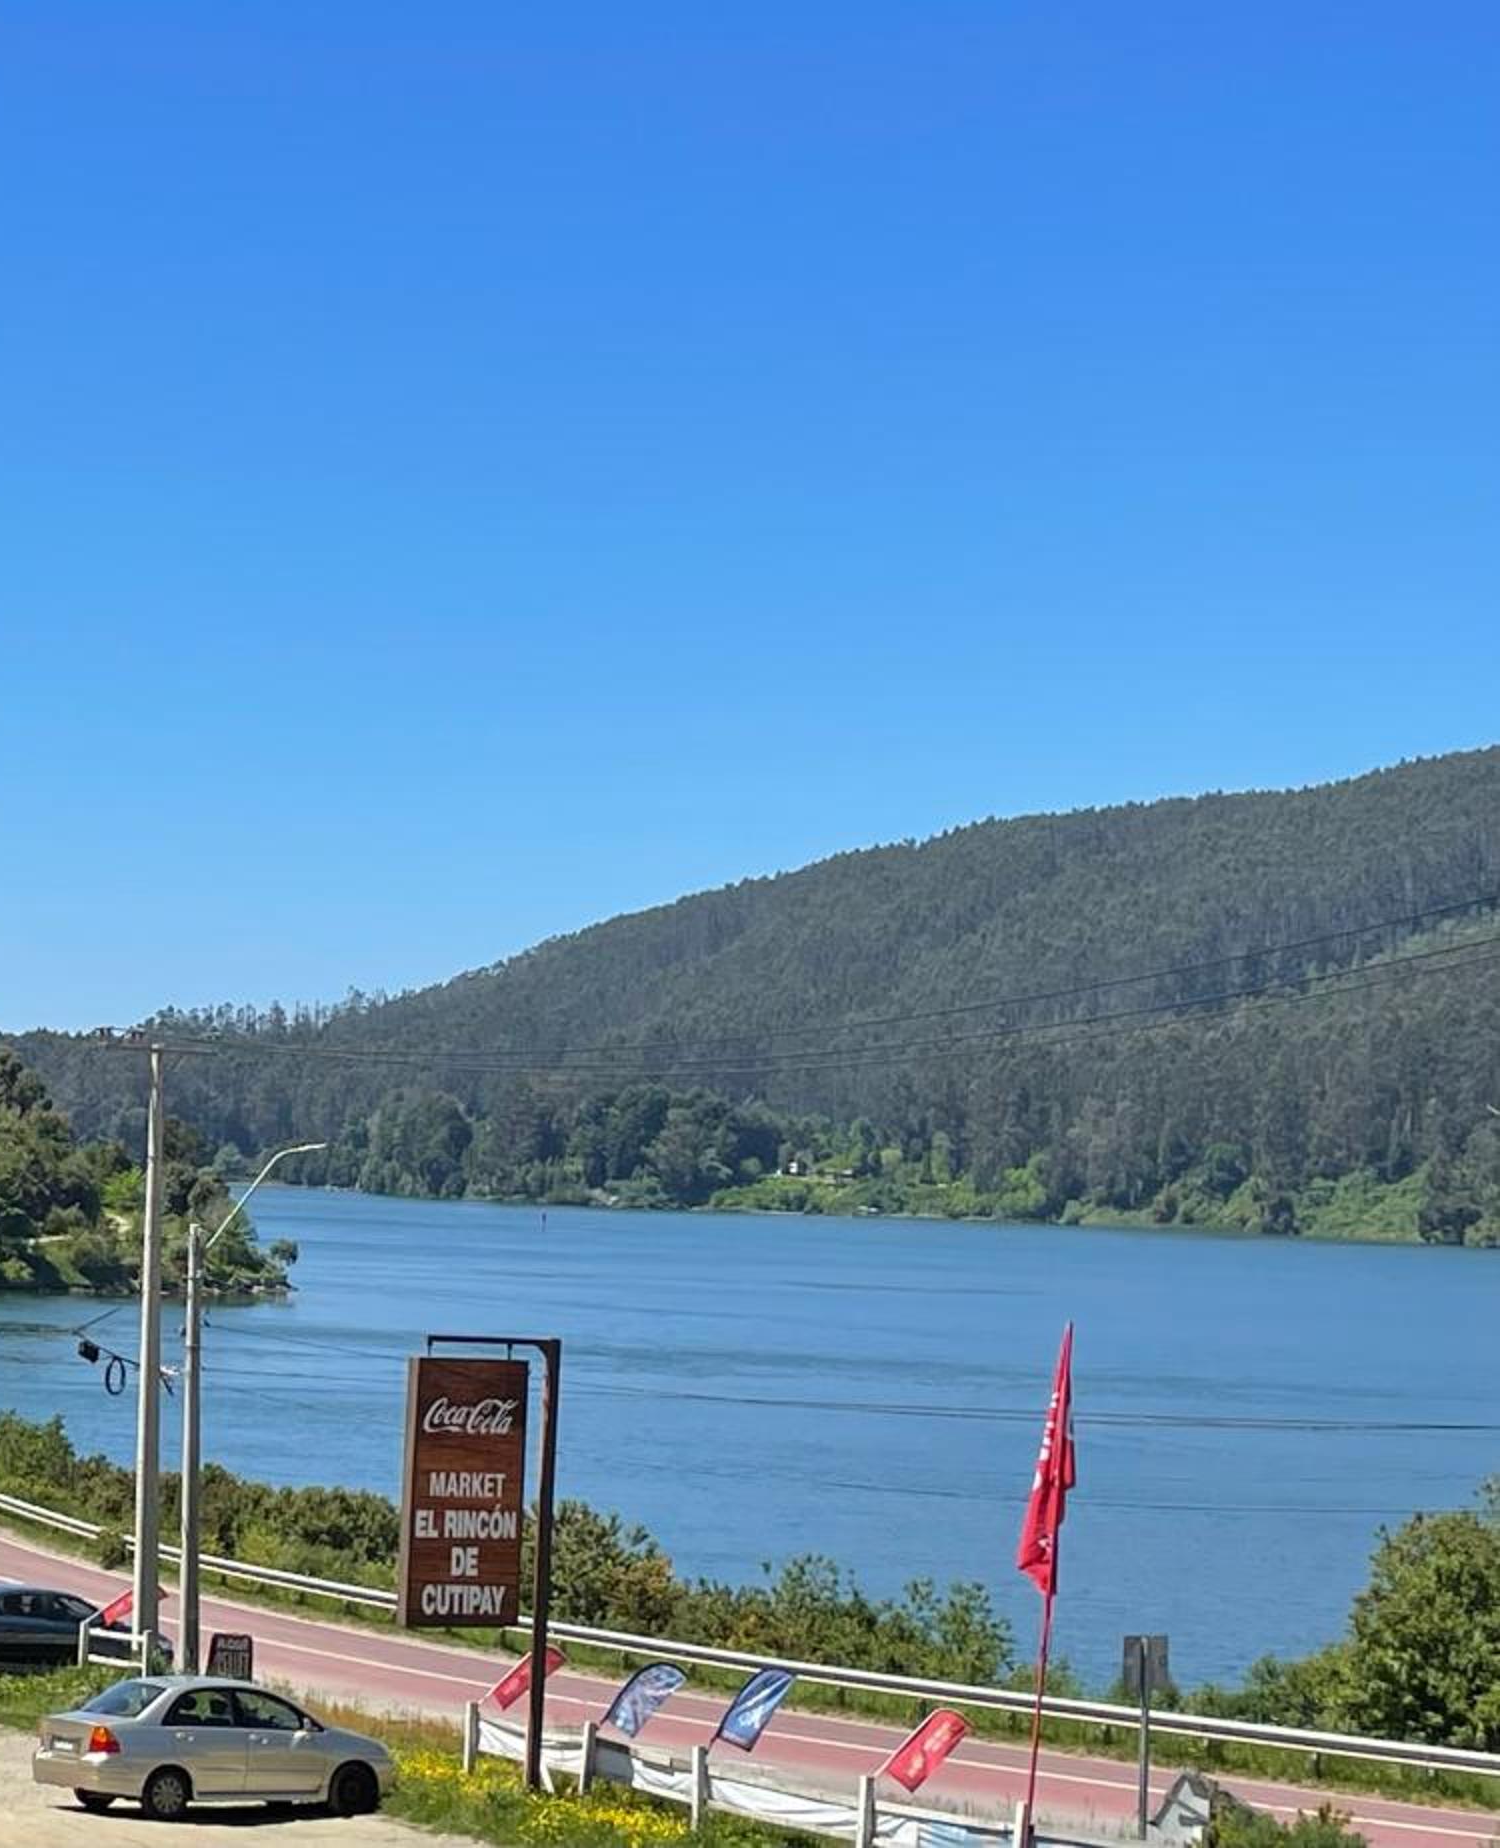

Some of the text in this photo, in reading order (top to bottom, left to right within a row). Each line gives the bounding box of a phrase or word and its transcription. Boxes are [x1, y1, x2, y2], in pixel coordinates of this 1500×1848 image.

[429, 1472, 507, 1498] MARKET
[415, 1504, 517, 1539] EL RINCÓN
[451, 1547, 479, 1577] DE
[421, 1584, 507, 1615] CUTIPAY
